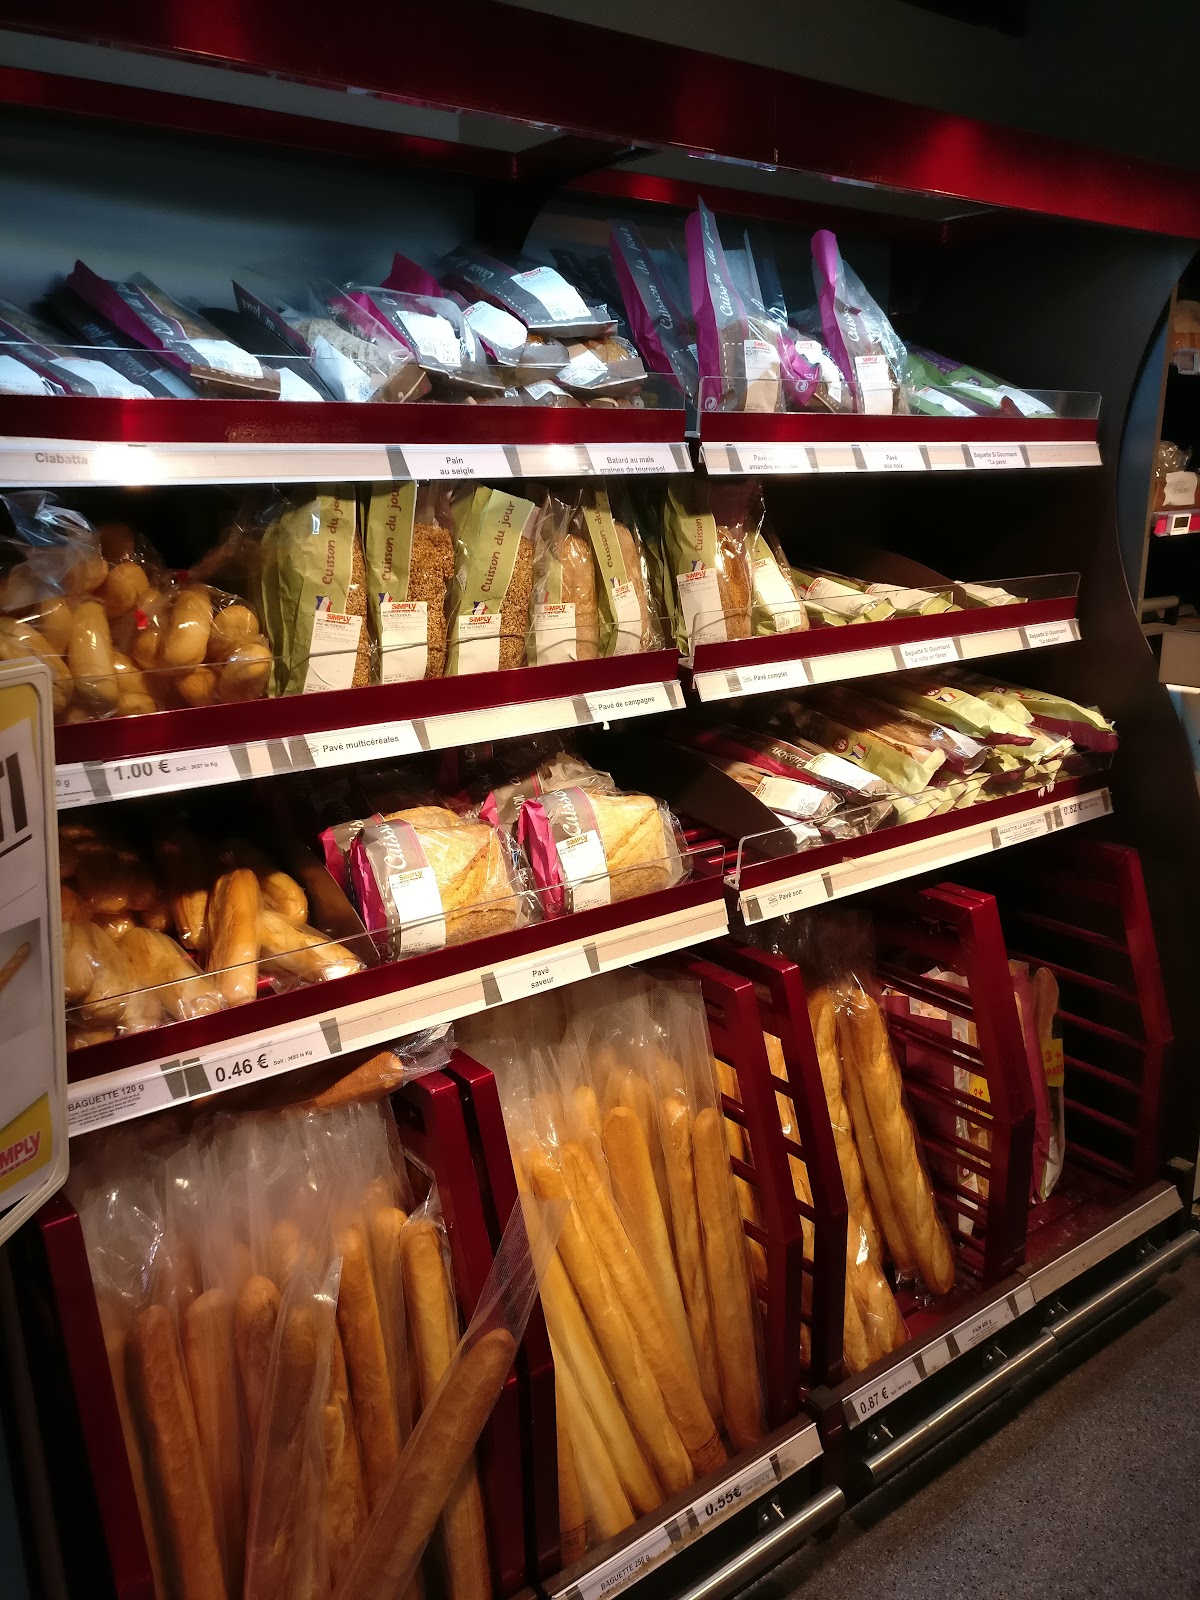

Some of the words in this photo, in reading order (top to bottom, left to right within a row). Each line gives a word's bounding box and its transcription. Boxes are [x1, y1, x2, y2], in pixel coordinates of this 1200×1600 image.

[35, 452, 89, 465] Ciabatta
[445, 456, 464, 465] Pain
[439, 467, 450, 475] au
[451, 466, 475, 476] seigle
[625, 465, 634, 473] de
[635, 465, 666, 473] tournesol
[385, 514, 397, 532] du
[498, 500, 516, 528] jour
[326, 517, 340, 534] du
[694, 517, 704, 551] Cuisson
[494, 529, 506, 546] du
[599, 528, 614, 569] Cuisson
[321, 539, 336, 585] Cuisson
[381, 537, 395, 581] Cuisson
[480, 550, 501, 593] Cuisson
[767, 671, 788, 680] complet
[598, 702, 614, 711] Pavé
[615, 700, 624, 708] de
[624, 696, 656, 709] campagne
[322, 740, 344, 753] Pavé
[345, 734, 400, 750] multicéréales
[114, 761, 154, 781] 1.00
[158, 759, 171, 774] €
[63, 779, 71, 788] g
[1063, 803, 1078, 816] 0.82
[1077, 801, 1084, 811] €
[532, 966, 550, 978] Pavé
[530, 976, 555, 989] saveur
[215, 1058, 253, 1082] 0.46
[257, 1053, 269, 1069] €
[67, 1089, 120, 1112] BAGUETTE
[121, 1084, 137, 1095] 120
[138, 1083, 145, 1092] g
[0, 1130, 40, 1171] MPLY
[859, 1390, 880, 1415] 0.87
[881, 1386, 889, 1401] €
[600, 1562, 634, 1591] BAGUETTE
